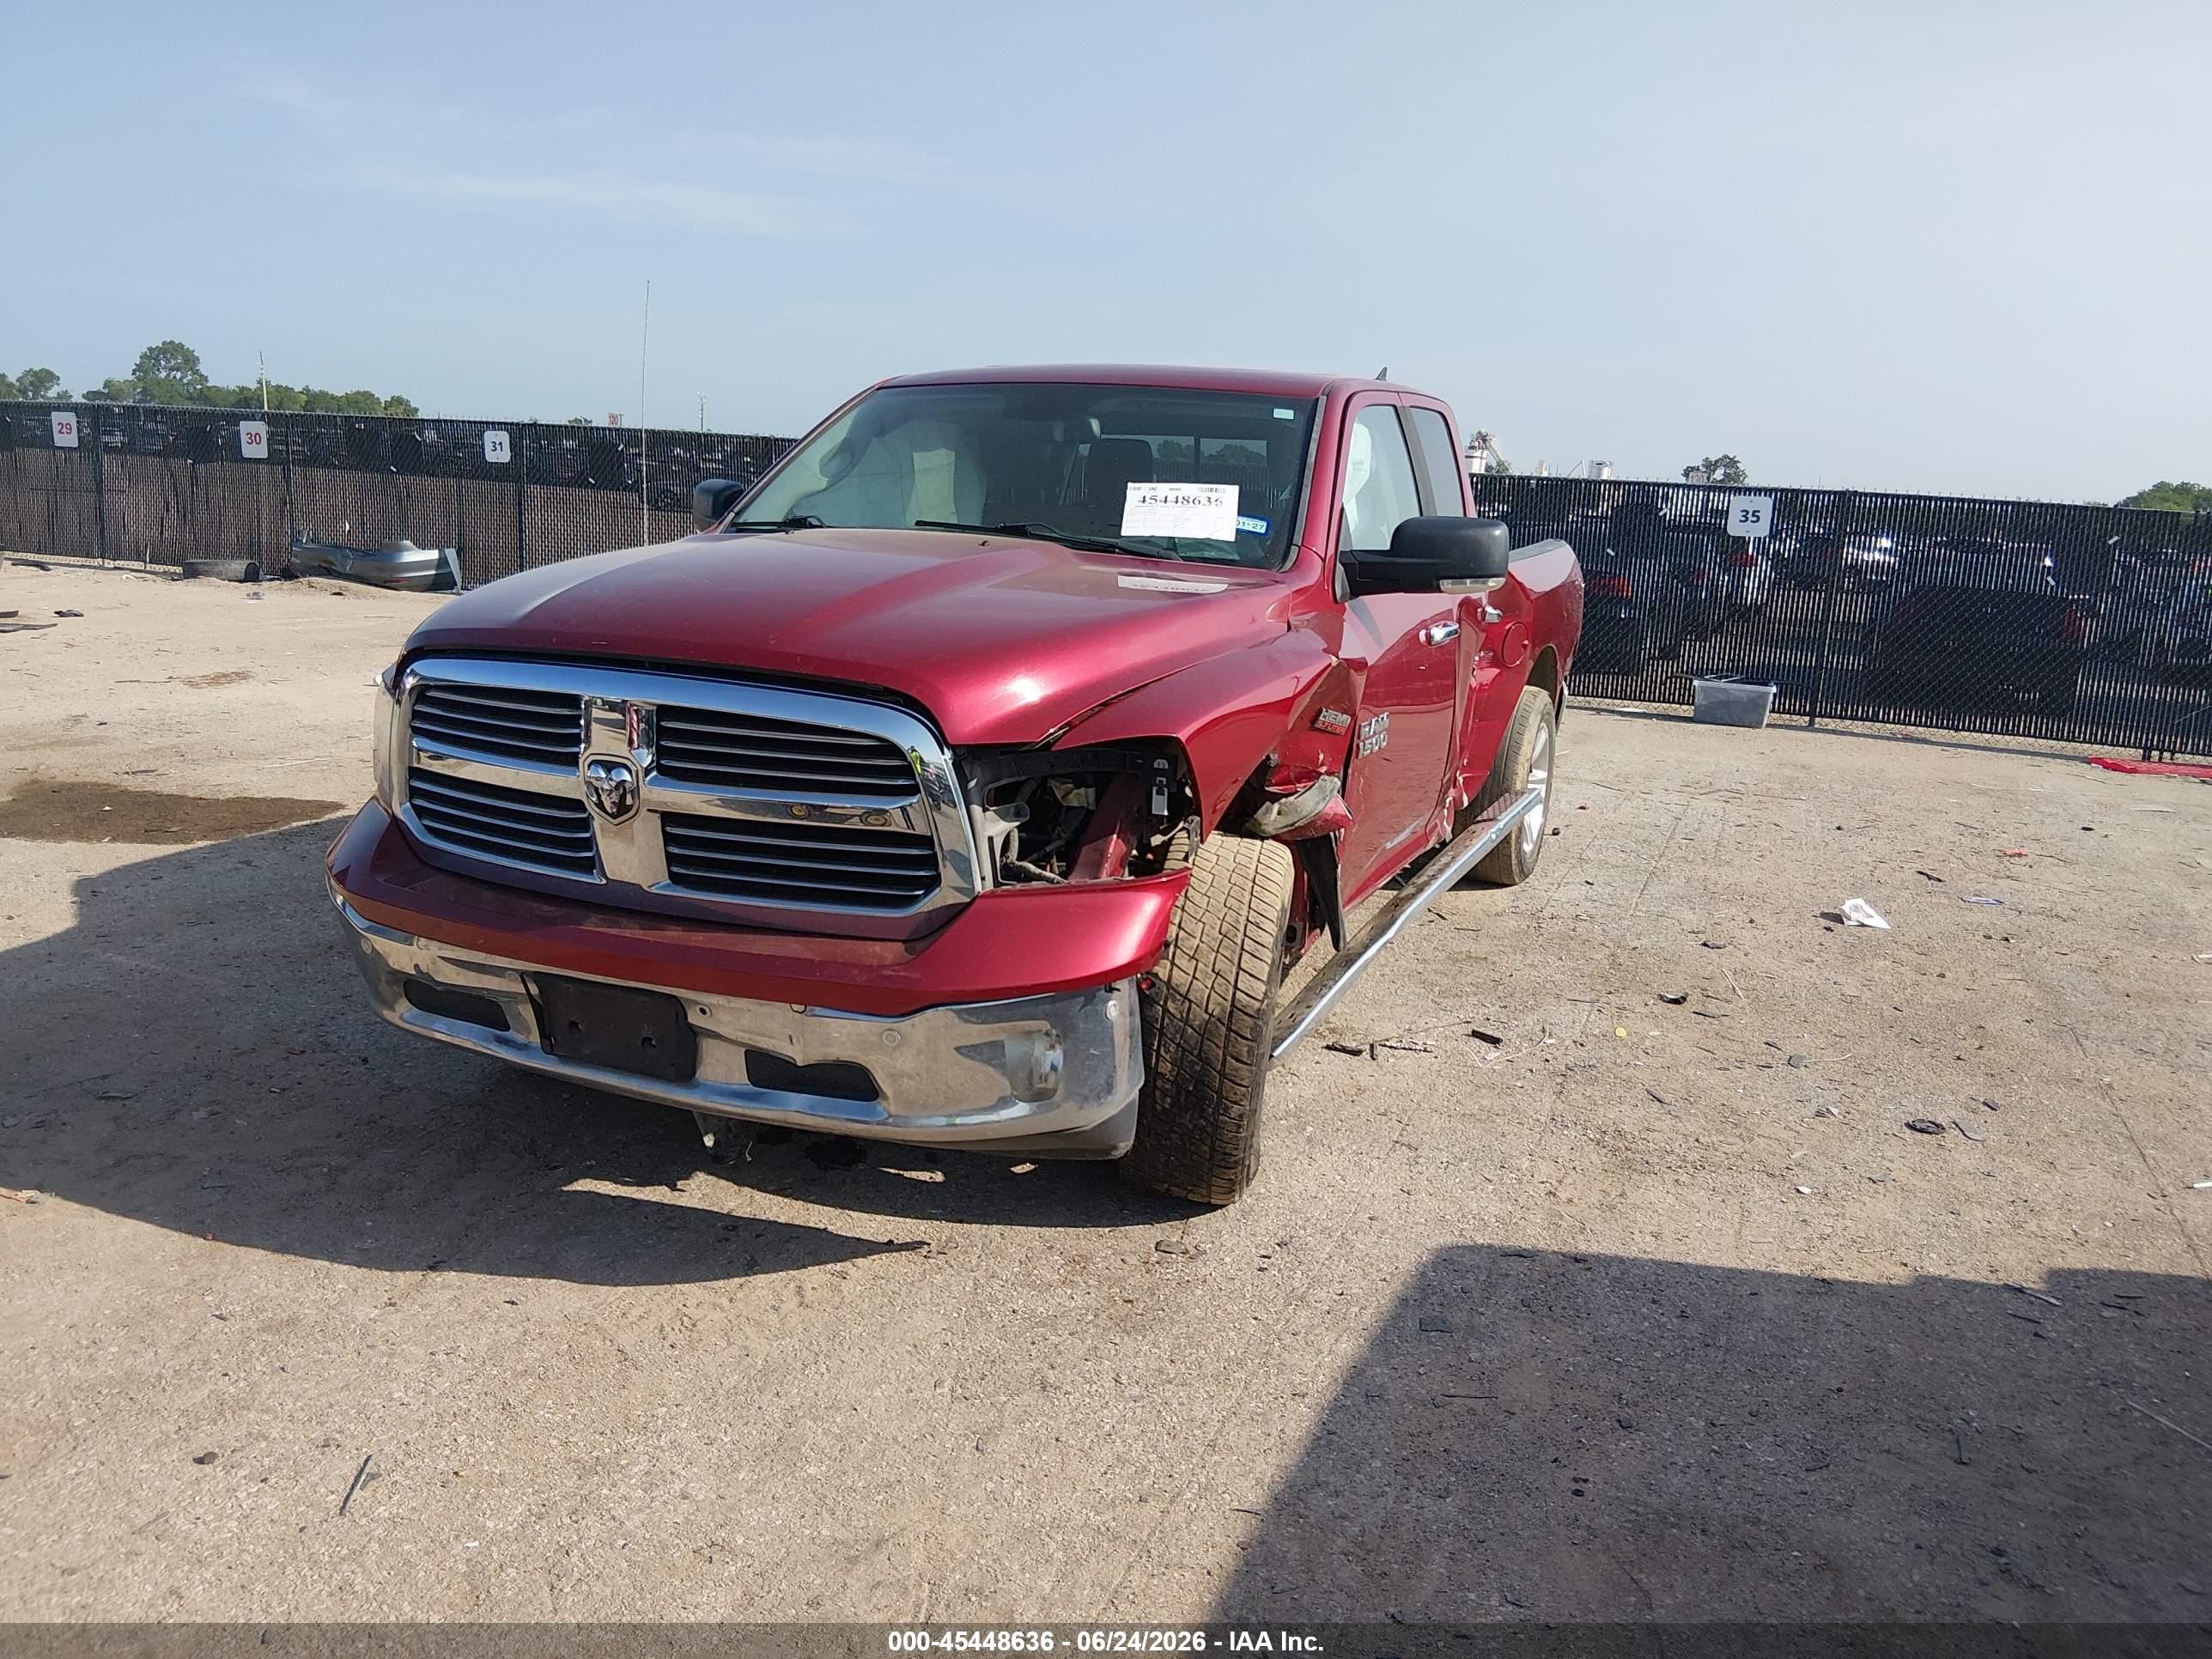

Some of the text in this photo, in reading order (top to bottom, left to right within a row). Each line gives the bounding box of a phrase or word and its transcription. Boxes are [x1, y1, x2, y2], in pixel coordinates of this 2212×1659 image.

[58, 422, 72, 434] 29
[246, 432, 262, 445] 30
[490, 441, 503, 453] 31
[1138, 495, 1223, 507] 45448636
[1739, 509, 1761, 524] 35
[1319, 707, 1352, 728] HEMI
[1358, 712, 1390, 742] RAM
[1358, 732, 1389, 760] 1500
